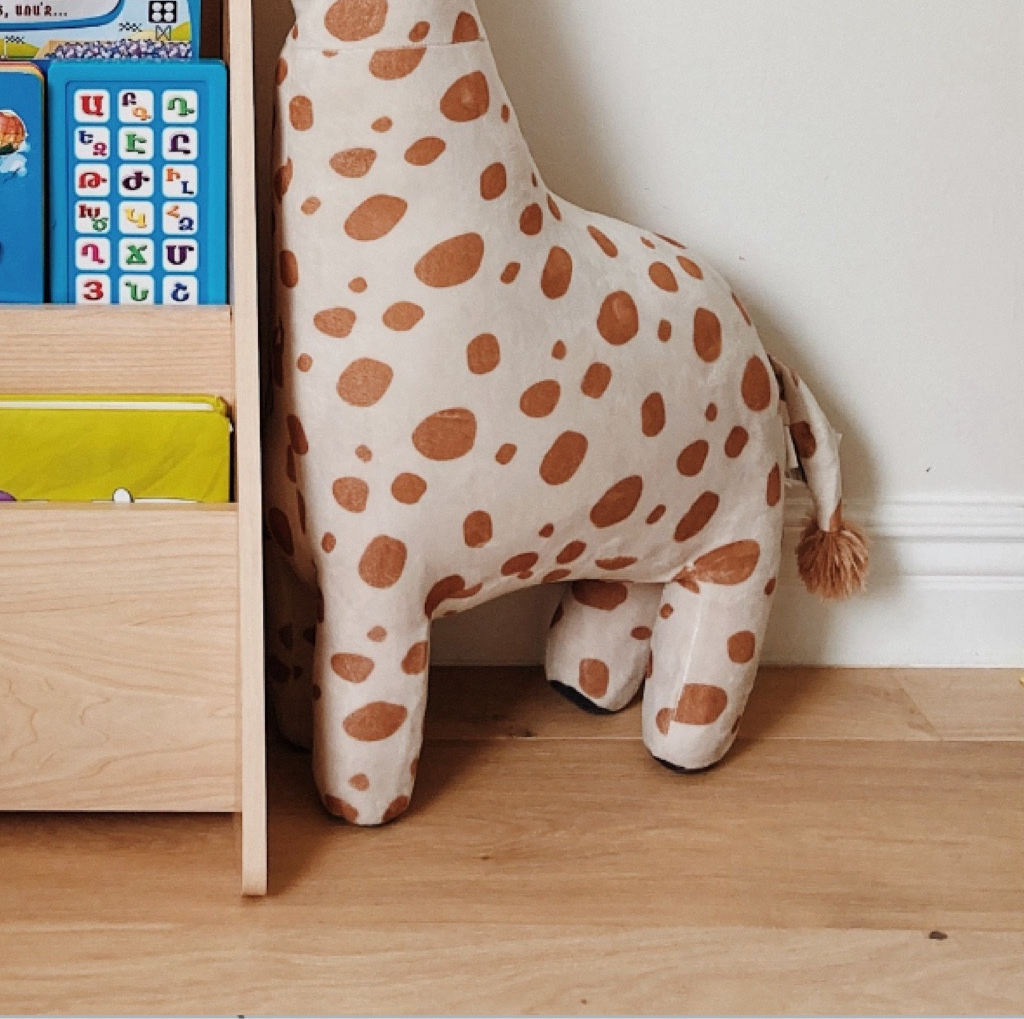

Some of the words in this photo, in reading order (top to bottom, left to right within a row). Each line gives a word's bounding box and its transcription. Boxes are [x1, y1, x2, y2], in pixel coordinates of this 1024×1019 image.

[80, 95, 104, 117] Ա
[122, 92, 137, 107] Բ
[132, 106, 151, 121] Գ
[167, 97, 195, 117] Դ
[78, 131, 94, 145] Ե
[92, 142, 107, 157] Զ
[125, 133, 147, 154] Է
[169, 134, 191, 154] Ը
[78, 172, 107, 189] Թ
[122, 171, 150, 190] Ժ
[166, 168, 181, 182] Ի
[181, 181, 194, 195] Լ
[78, 205, 100, 218] Խ
[125, 208, 147, 229] Կ
[166, 205, 180, 218] Հ
[179, 217, 194, 231] Ձ
[81, 243, 105, 264] Ղ
[126, 244, 147, 265] Ճ
[166, 245, 194, 265] Մ
[83, 281, 104, 301] Յ
[125, 281, 149, 302] Ն
[170, 282, 190, 302] Շ
